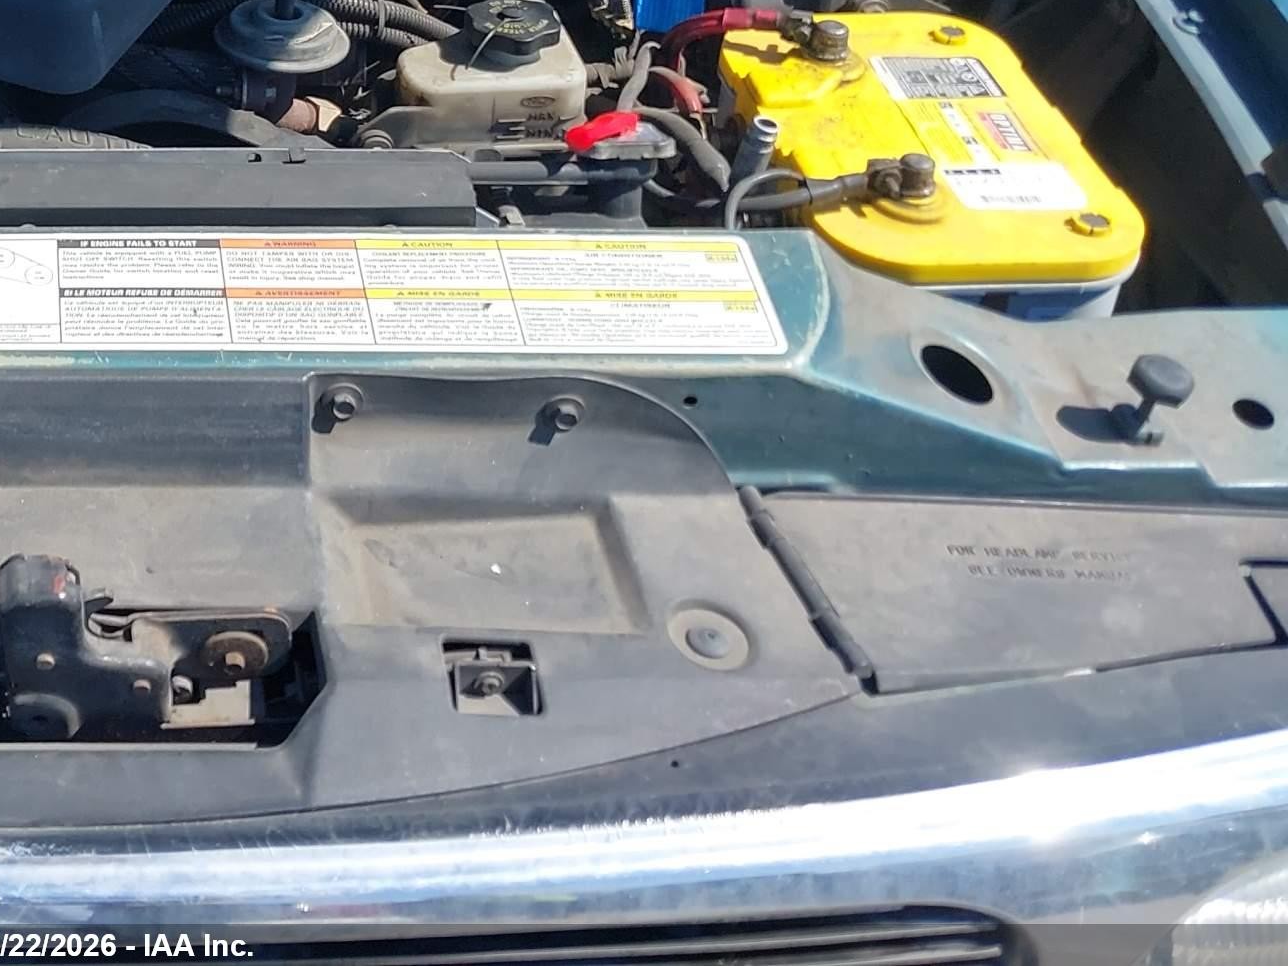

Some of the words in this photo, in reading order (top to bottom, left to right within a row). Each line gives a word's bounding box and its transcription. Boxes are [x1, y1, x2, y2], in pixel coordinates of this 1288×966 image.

[63, 289, 71, 297] SI
[74, 289, 84, 297] LE
[86, 289, 123, 297] MOTEUR
[125, 289, 158, 297] REFUSE
[160, 289, 171, 297] DE
[174, 289, 223, 297] DÉMARRER
